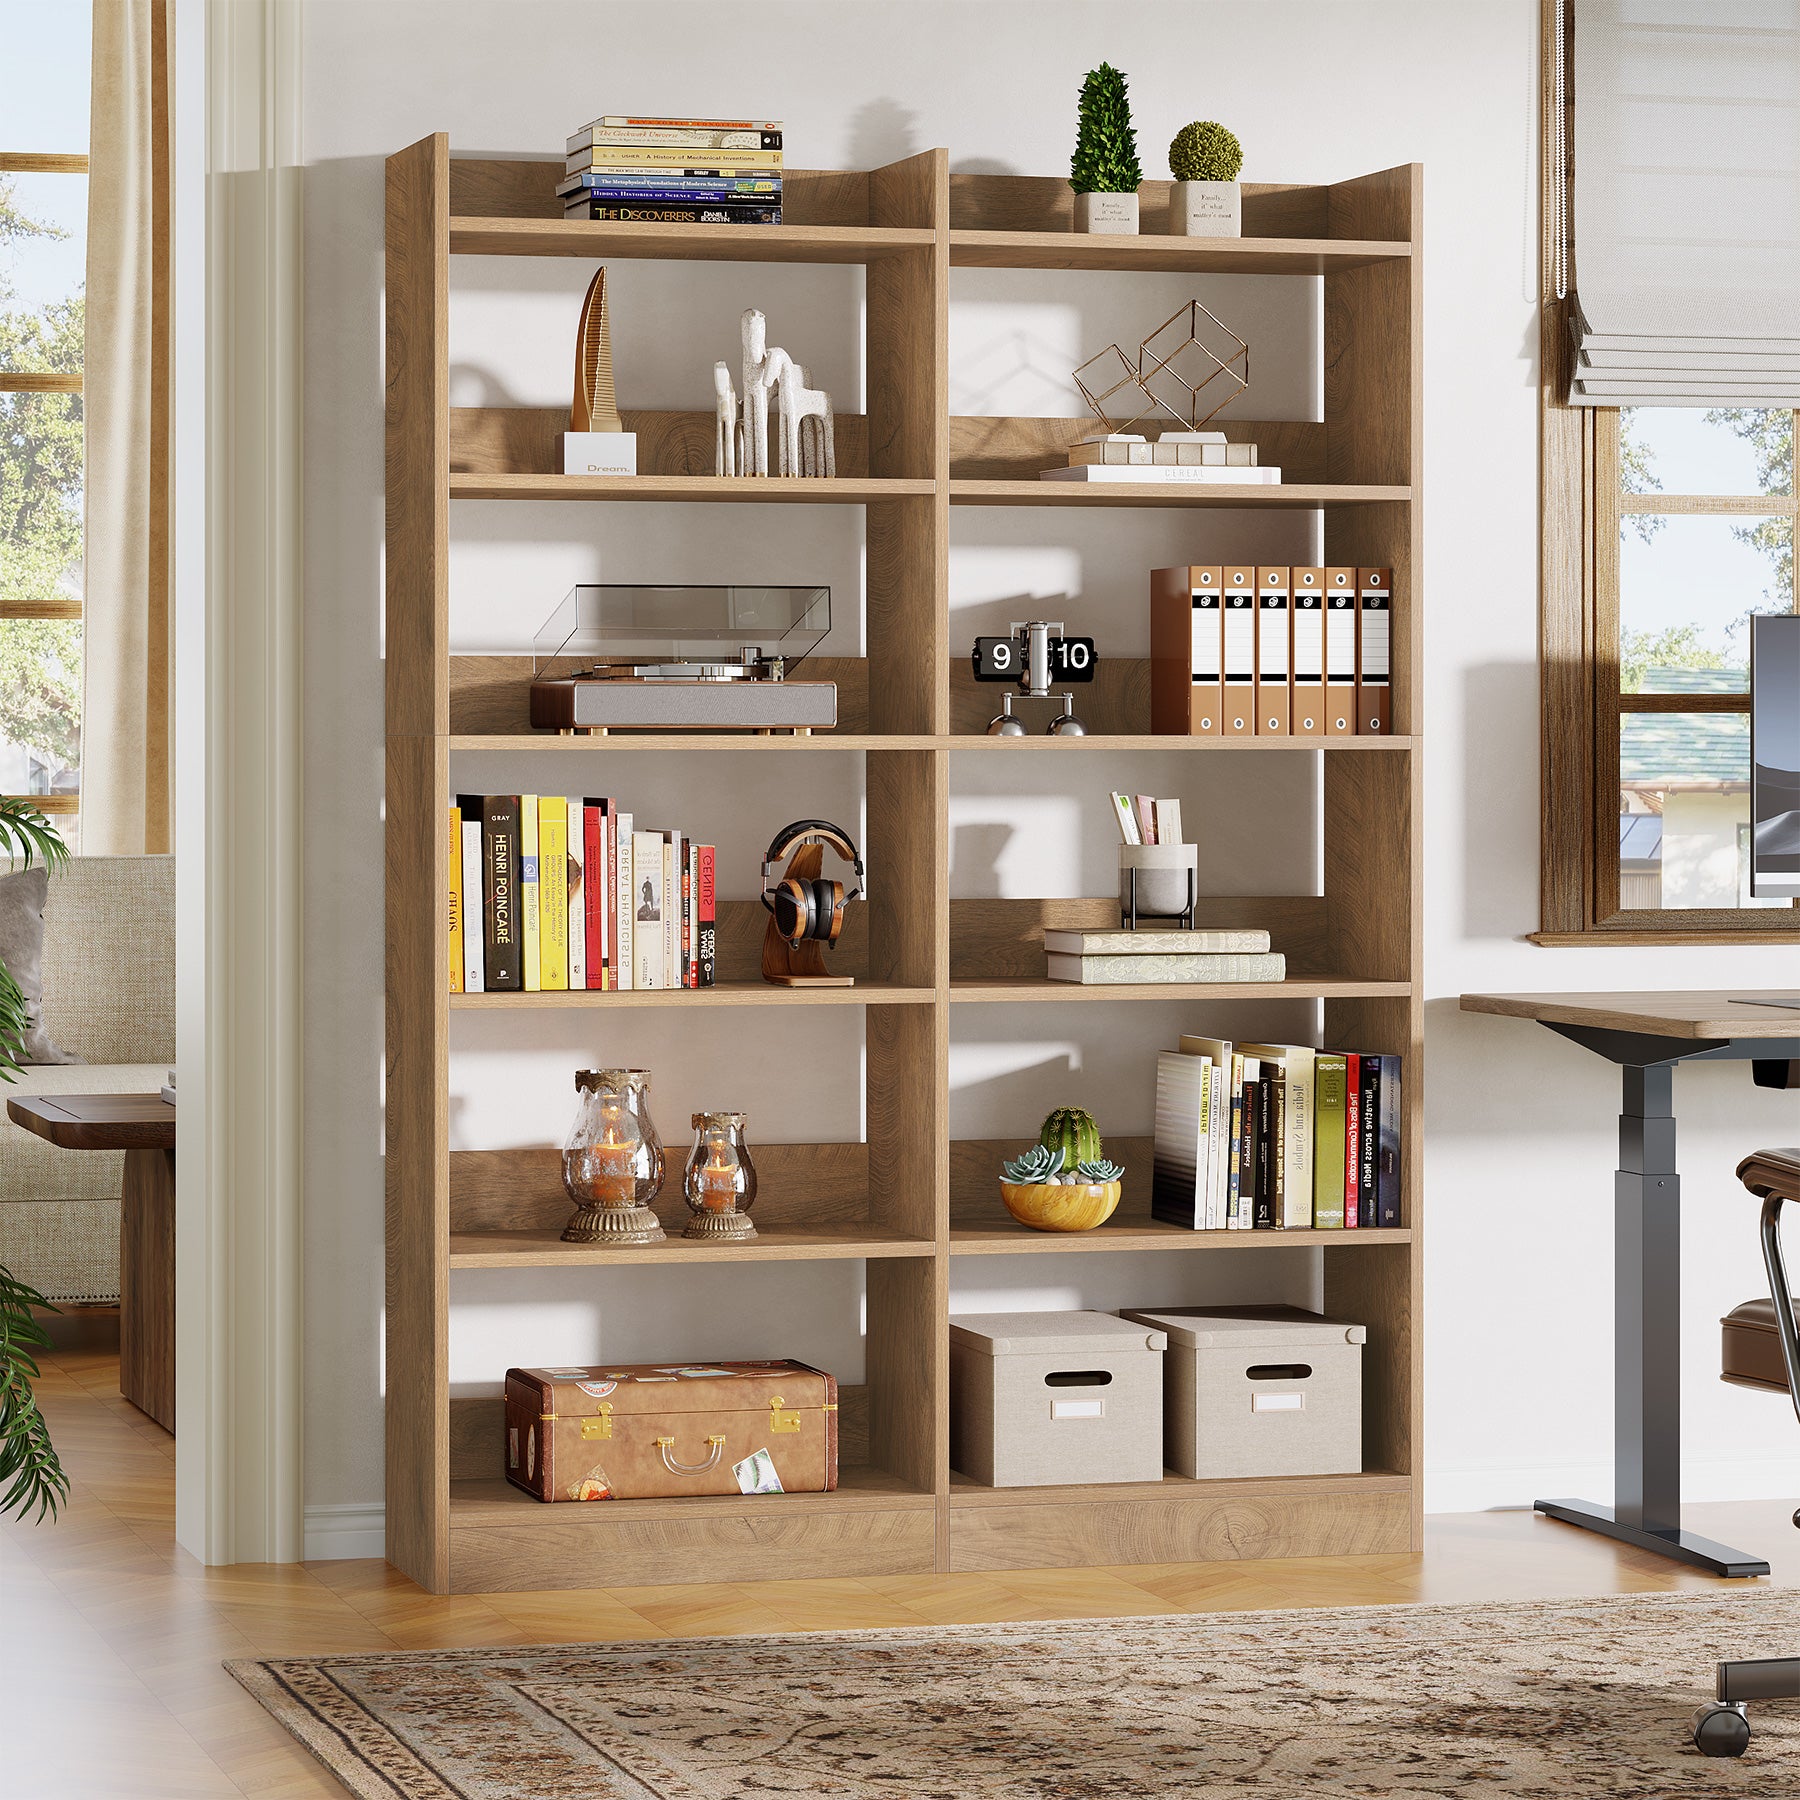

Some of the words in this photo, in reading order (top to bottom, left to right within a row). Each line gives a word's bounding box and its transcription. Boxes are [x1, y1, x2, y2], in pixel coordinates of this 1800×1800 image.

[595, 208, 618, 219] THE
[620, 208, 696, 222] DISCOVERERS
[588, 464, 630, 472] Dream.
[1165, 468, 1204, 478] CEREAL
[993, 643, 1011, 670] 9
[1057, 643, 1089, 669] 10
[495, 834, 507, 874] HENRI
[449, 891, 457, 932] CHAOS
[496, 878, 510, 944] POINCARÉ
[528, 904, 537, 932] Poincaré
